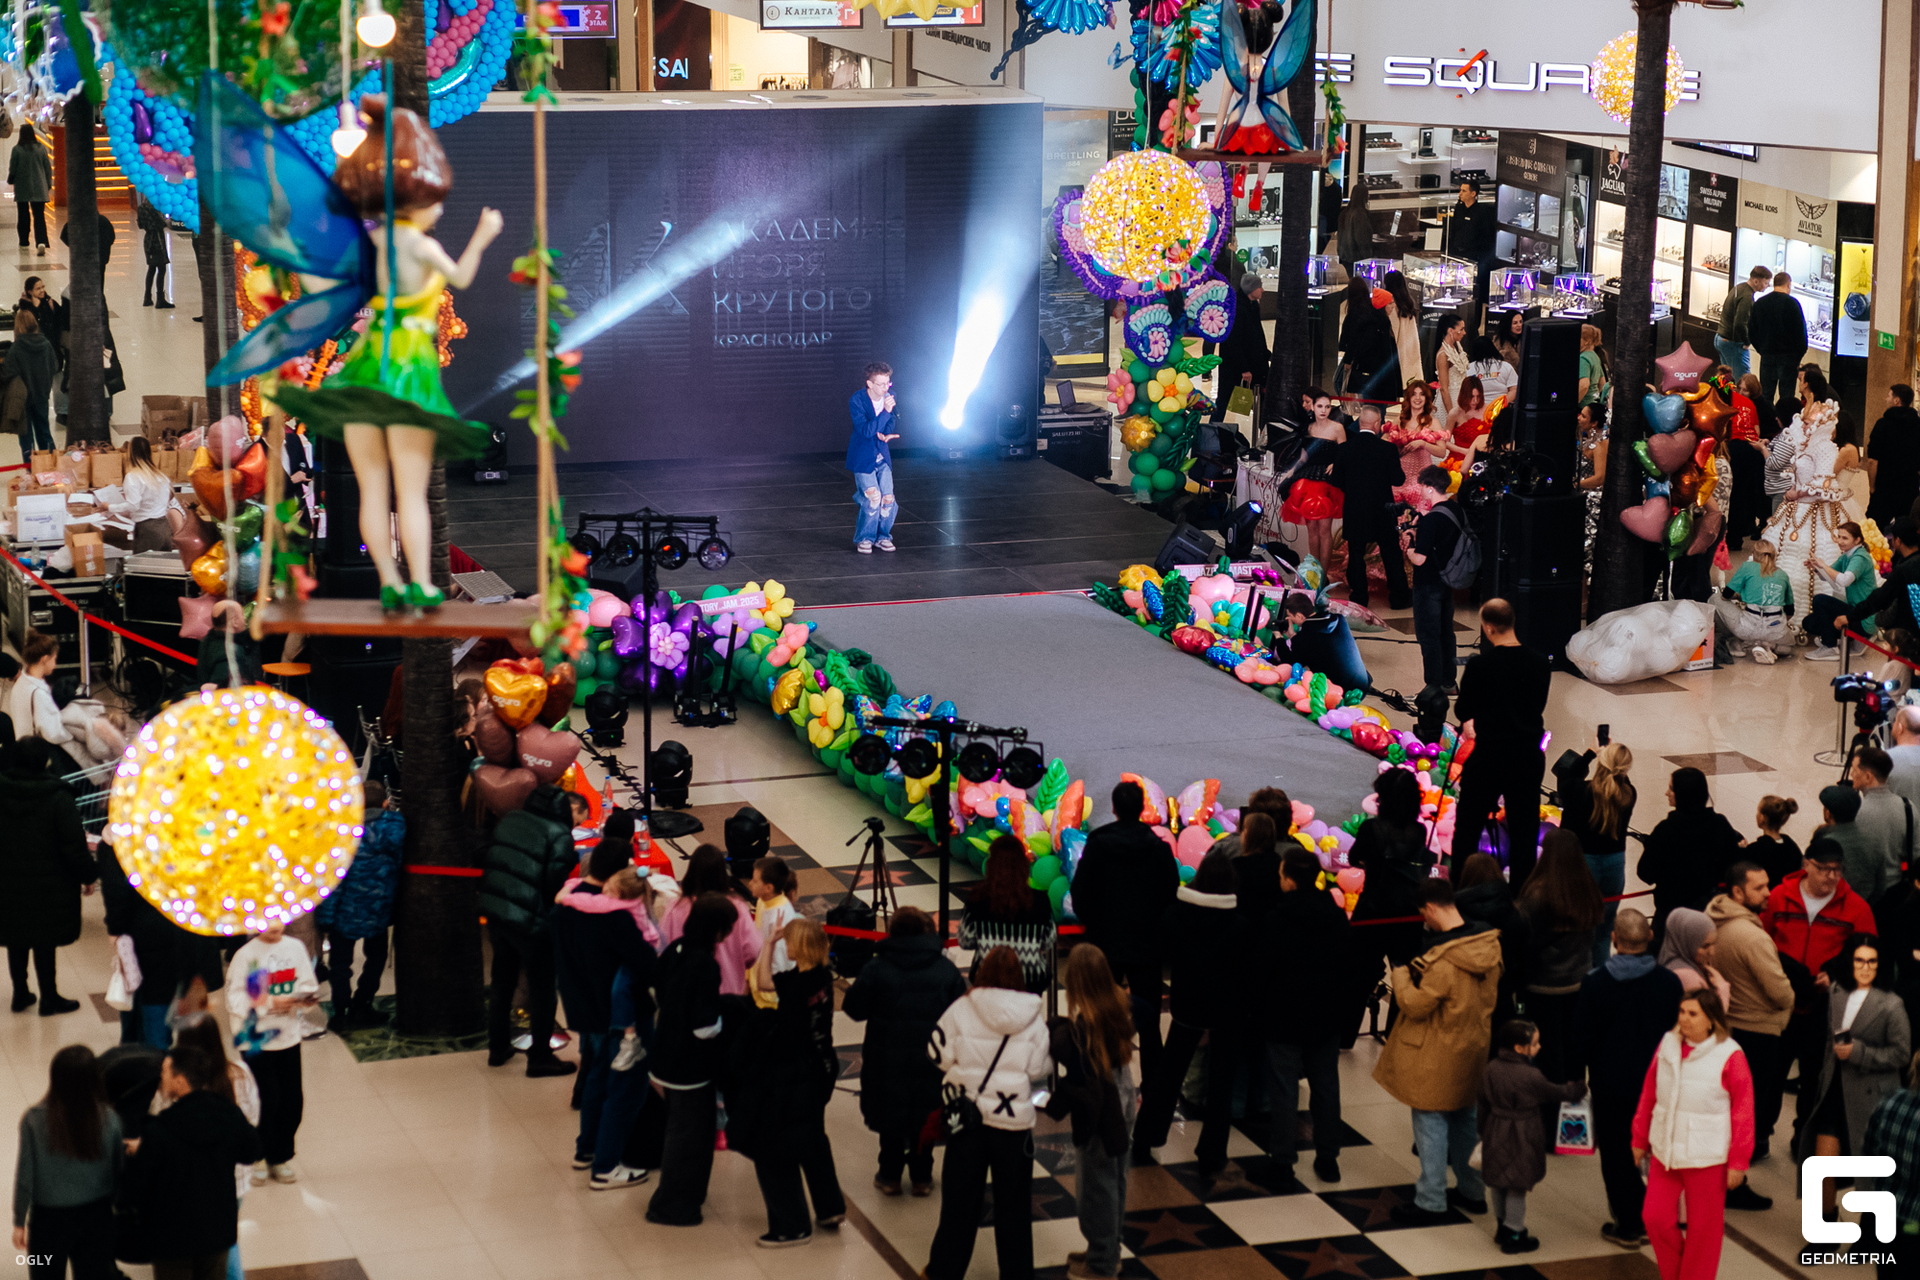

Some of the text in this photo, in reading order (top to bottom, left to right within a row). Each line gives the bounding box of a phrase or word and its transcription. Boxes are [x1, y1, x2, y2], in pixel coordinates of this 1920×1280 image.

[594, 10, 602, 19] 2
[1383, 50, 1700, 100] SQUA
[1046, 150, 1101, 160] BREITLING
[1600, 177, 1626, 196] JAGUAR
[1700, 186, 1727, 199] SWISS ALPINE
[1703, 196, 1723, 207] MILITARY
[1744, 200, 1778, 214] MICHAEL KORS
[1797, 219, 1822, 233] AVIATOR
[713, 289, 872, 314] КРУТОГО
[713, 332, 833, 348] КРАСНОДАР
[1674, 372, 1698, 381] agura
[492, 695, 521, 708] agura
[523, 753, 552, 767] agura
